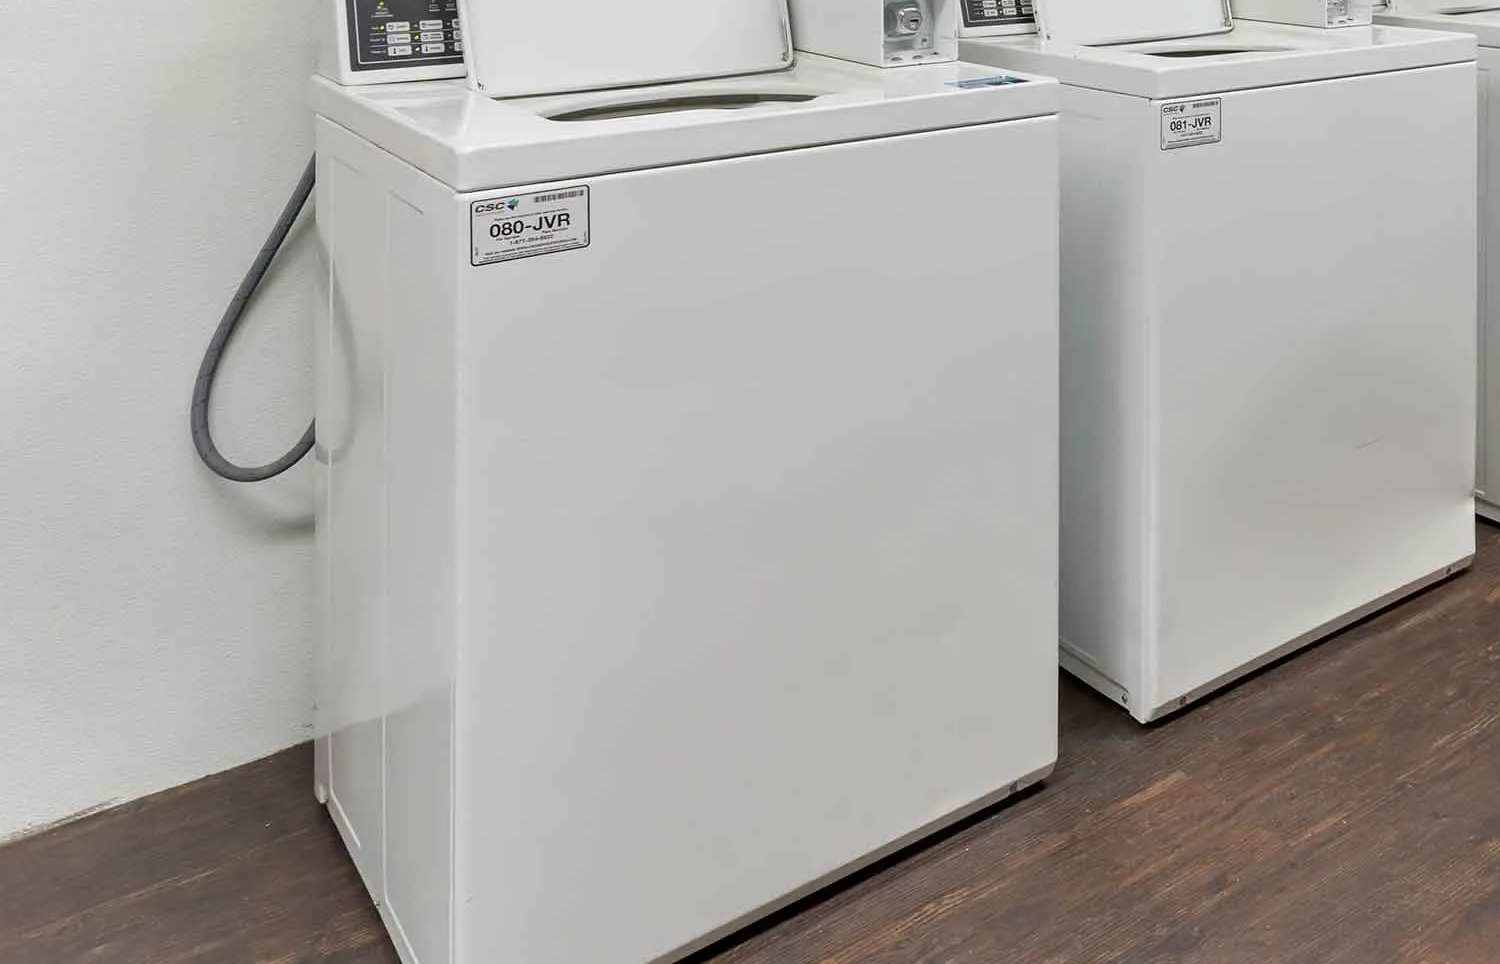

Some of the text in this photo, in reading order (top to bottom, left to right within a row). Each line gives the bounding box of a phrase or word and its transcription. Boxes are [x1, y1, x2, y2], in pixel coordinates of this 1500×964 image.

[1170, 116, 1212, 131] 081-JVR
[475, 202, 505, 213] CSC
[490, 213, 570, 238] 080-JVR
